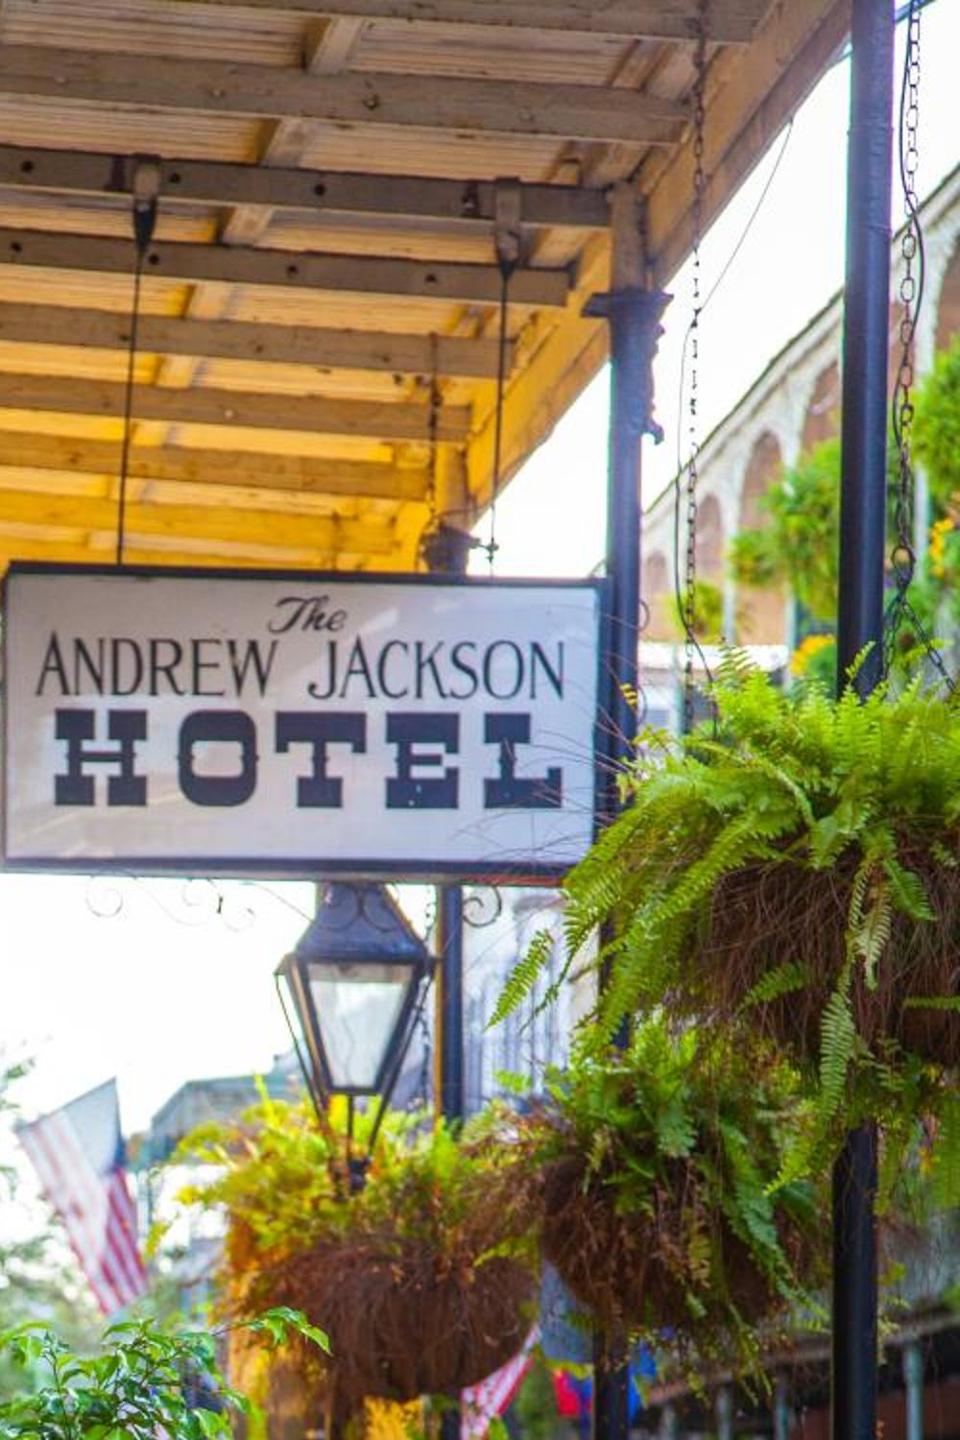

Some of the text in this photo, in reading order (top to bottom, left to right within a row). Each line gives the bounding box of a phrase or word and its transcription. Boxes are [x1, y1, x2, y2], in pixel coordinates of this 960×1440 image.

[268, 595, 347, 633] The
[36, 633, 565, 699] ANDREW JACKSON
[54, 709, 563, 809] HOTEL
